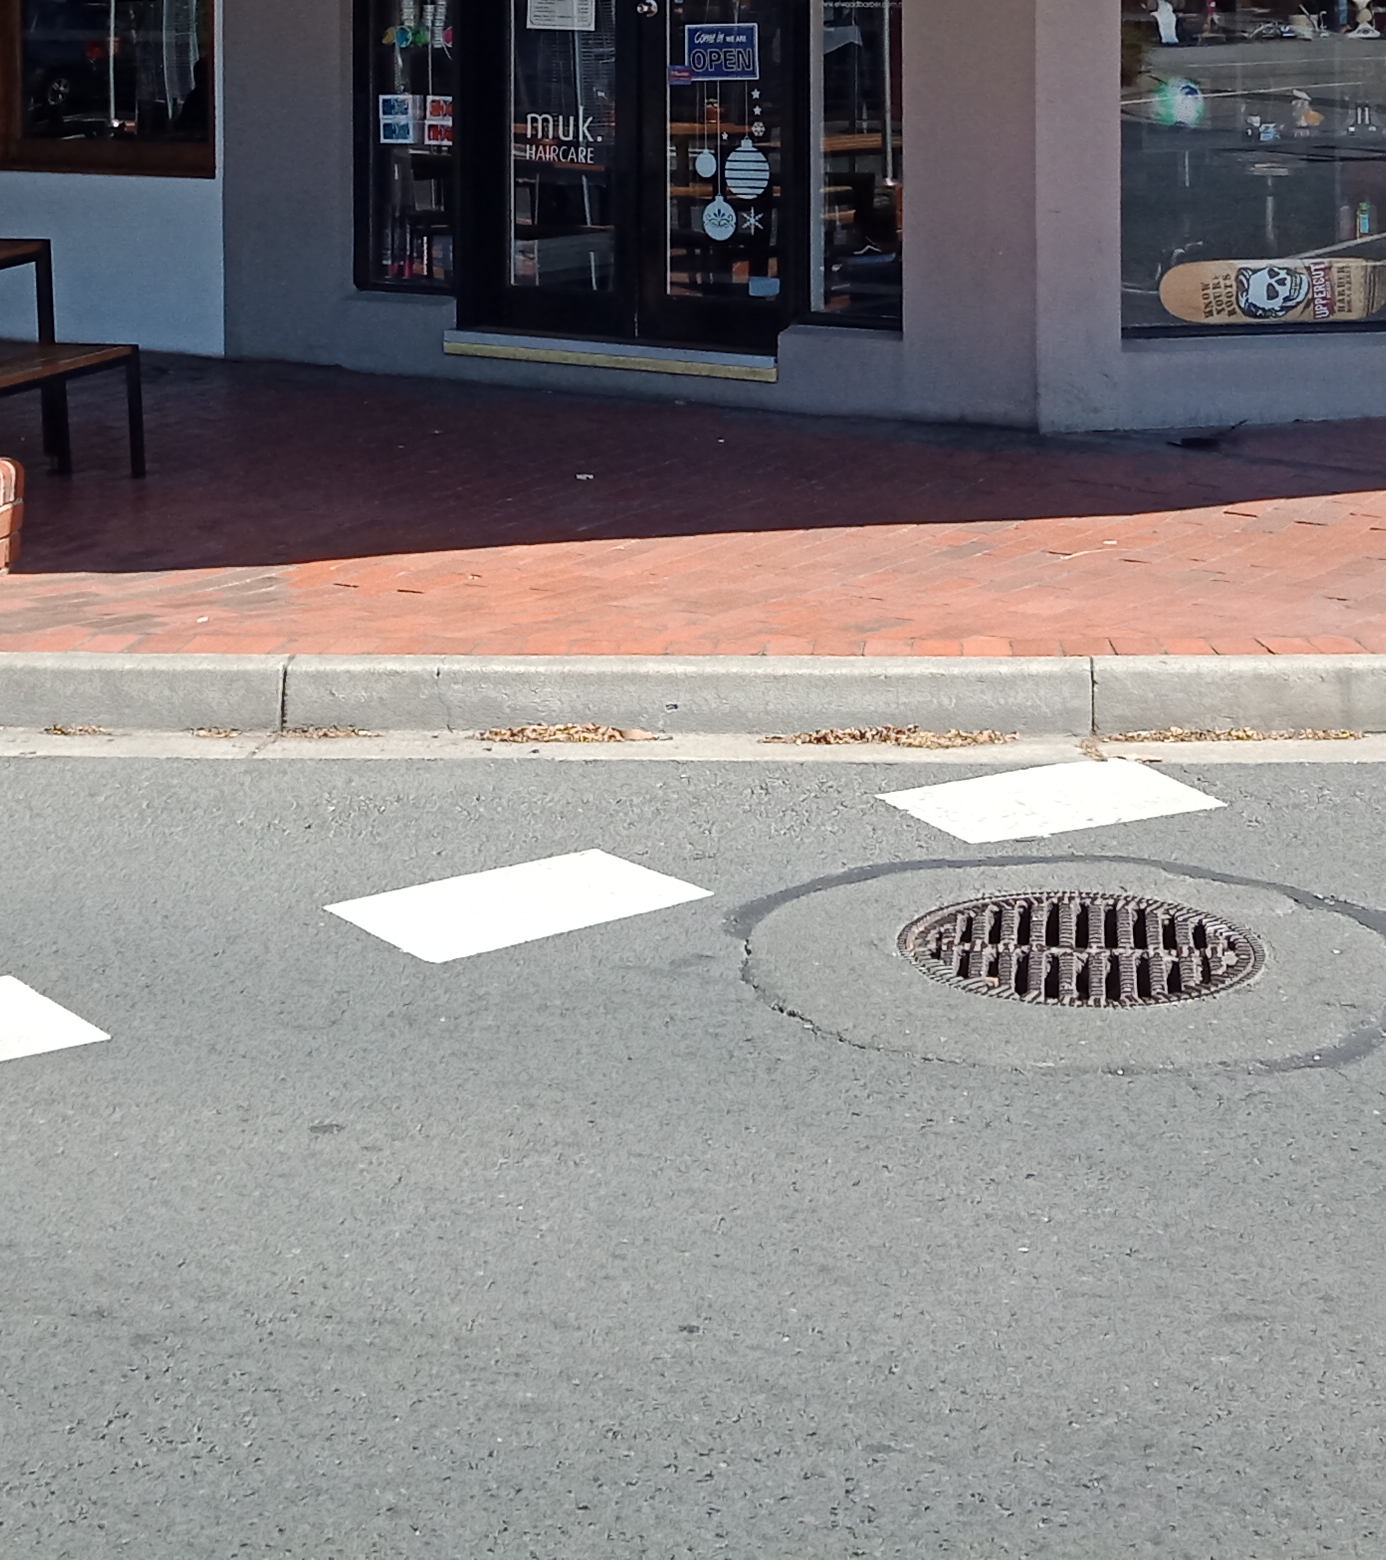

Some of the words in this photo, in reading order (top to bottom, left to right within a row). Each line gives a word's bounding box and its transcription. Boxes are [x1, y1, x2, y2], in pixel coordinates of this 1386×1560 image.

[691, 48, 753, 72] OPEN
[526, 144, 595, 164] HAIRCARE
[1211, 280, 1226, 316] YOUR
[1221, 273, 1237, 318] ROOTS
[1310, 260, 1330, 320] UPPERCUT
